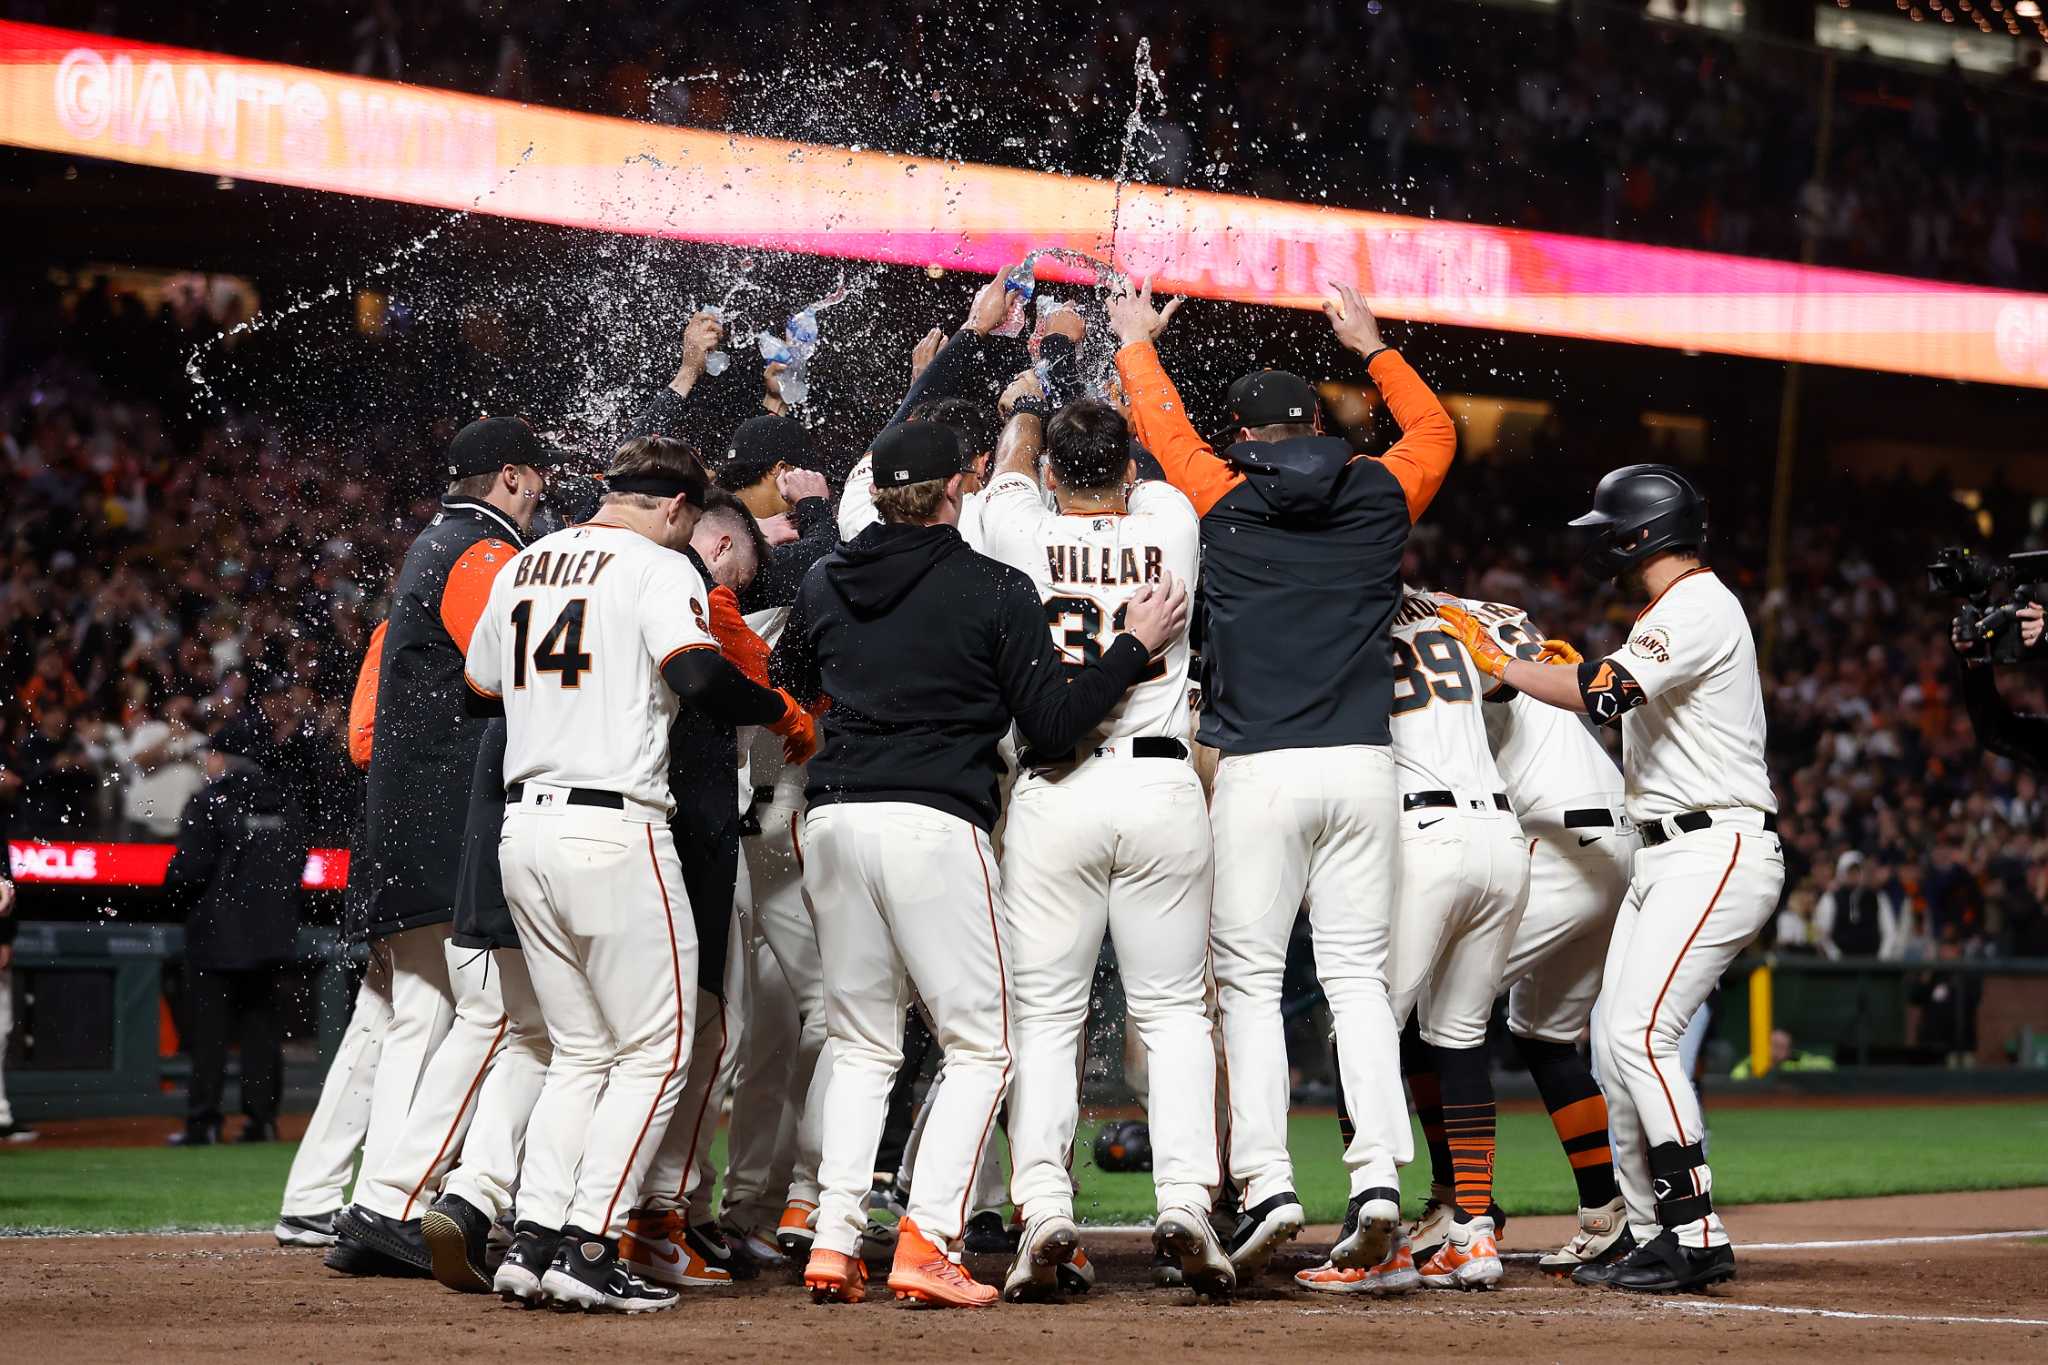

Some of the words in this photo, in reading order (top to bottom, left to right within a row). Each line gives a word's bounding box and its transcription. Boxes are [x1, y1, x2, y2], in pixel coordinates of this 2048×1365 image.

[56, 47, 328, 166] GIANTS
[513, 549, 615, 587] BAILEY
[1046, 545, 1163, 584] VILLAR
[510, 598, 592, 689] 14
